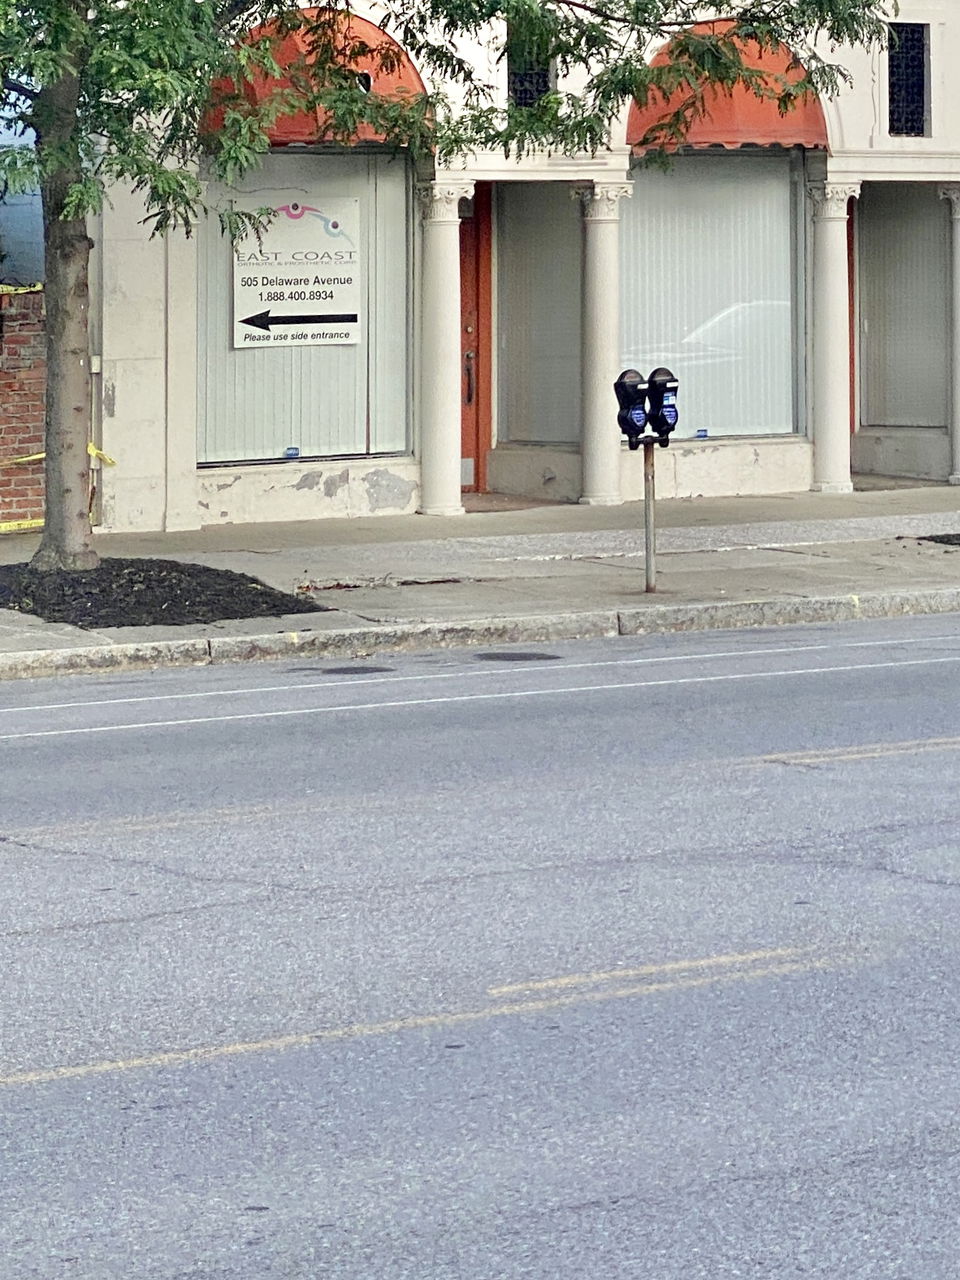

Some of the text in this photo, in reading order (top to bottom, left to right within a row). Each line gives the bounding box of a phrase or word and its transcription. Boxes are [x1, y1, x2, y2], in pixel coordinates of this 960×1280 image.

[237, 251, 356, 262] EAST COAST
[240, 275, 353, 287] 505 Delaware Avenue
[258, 290, 334, 302] 1.888.400.8934
[244, 331, 350, 342] Please use side entrance
